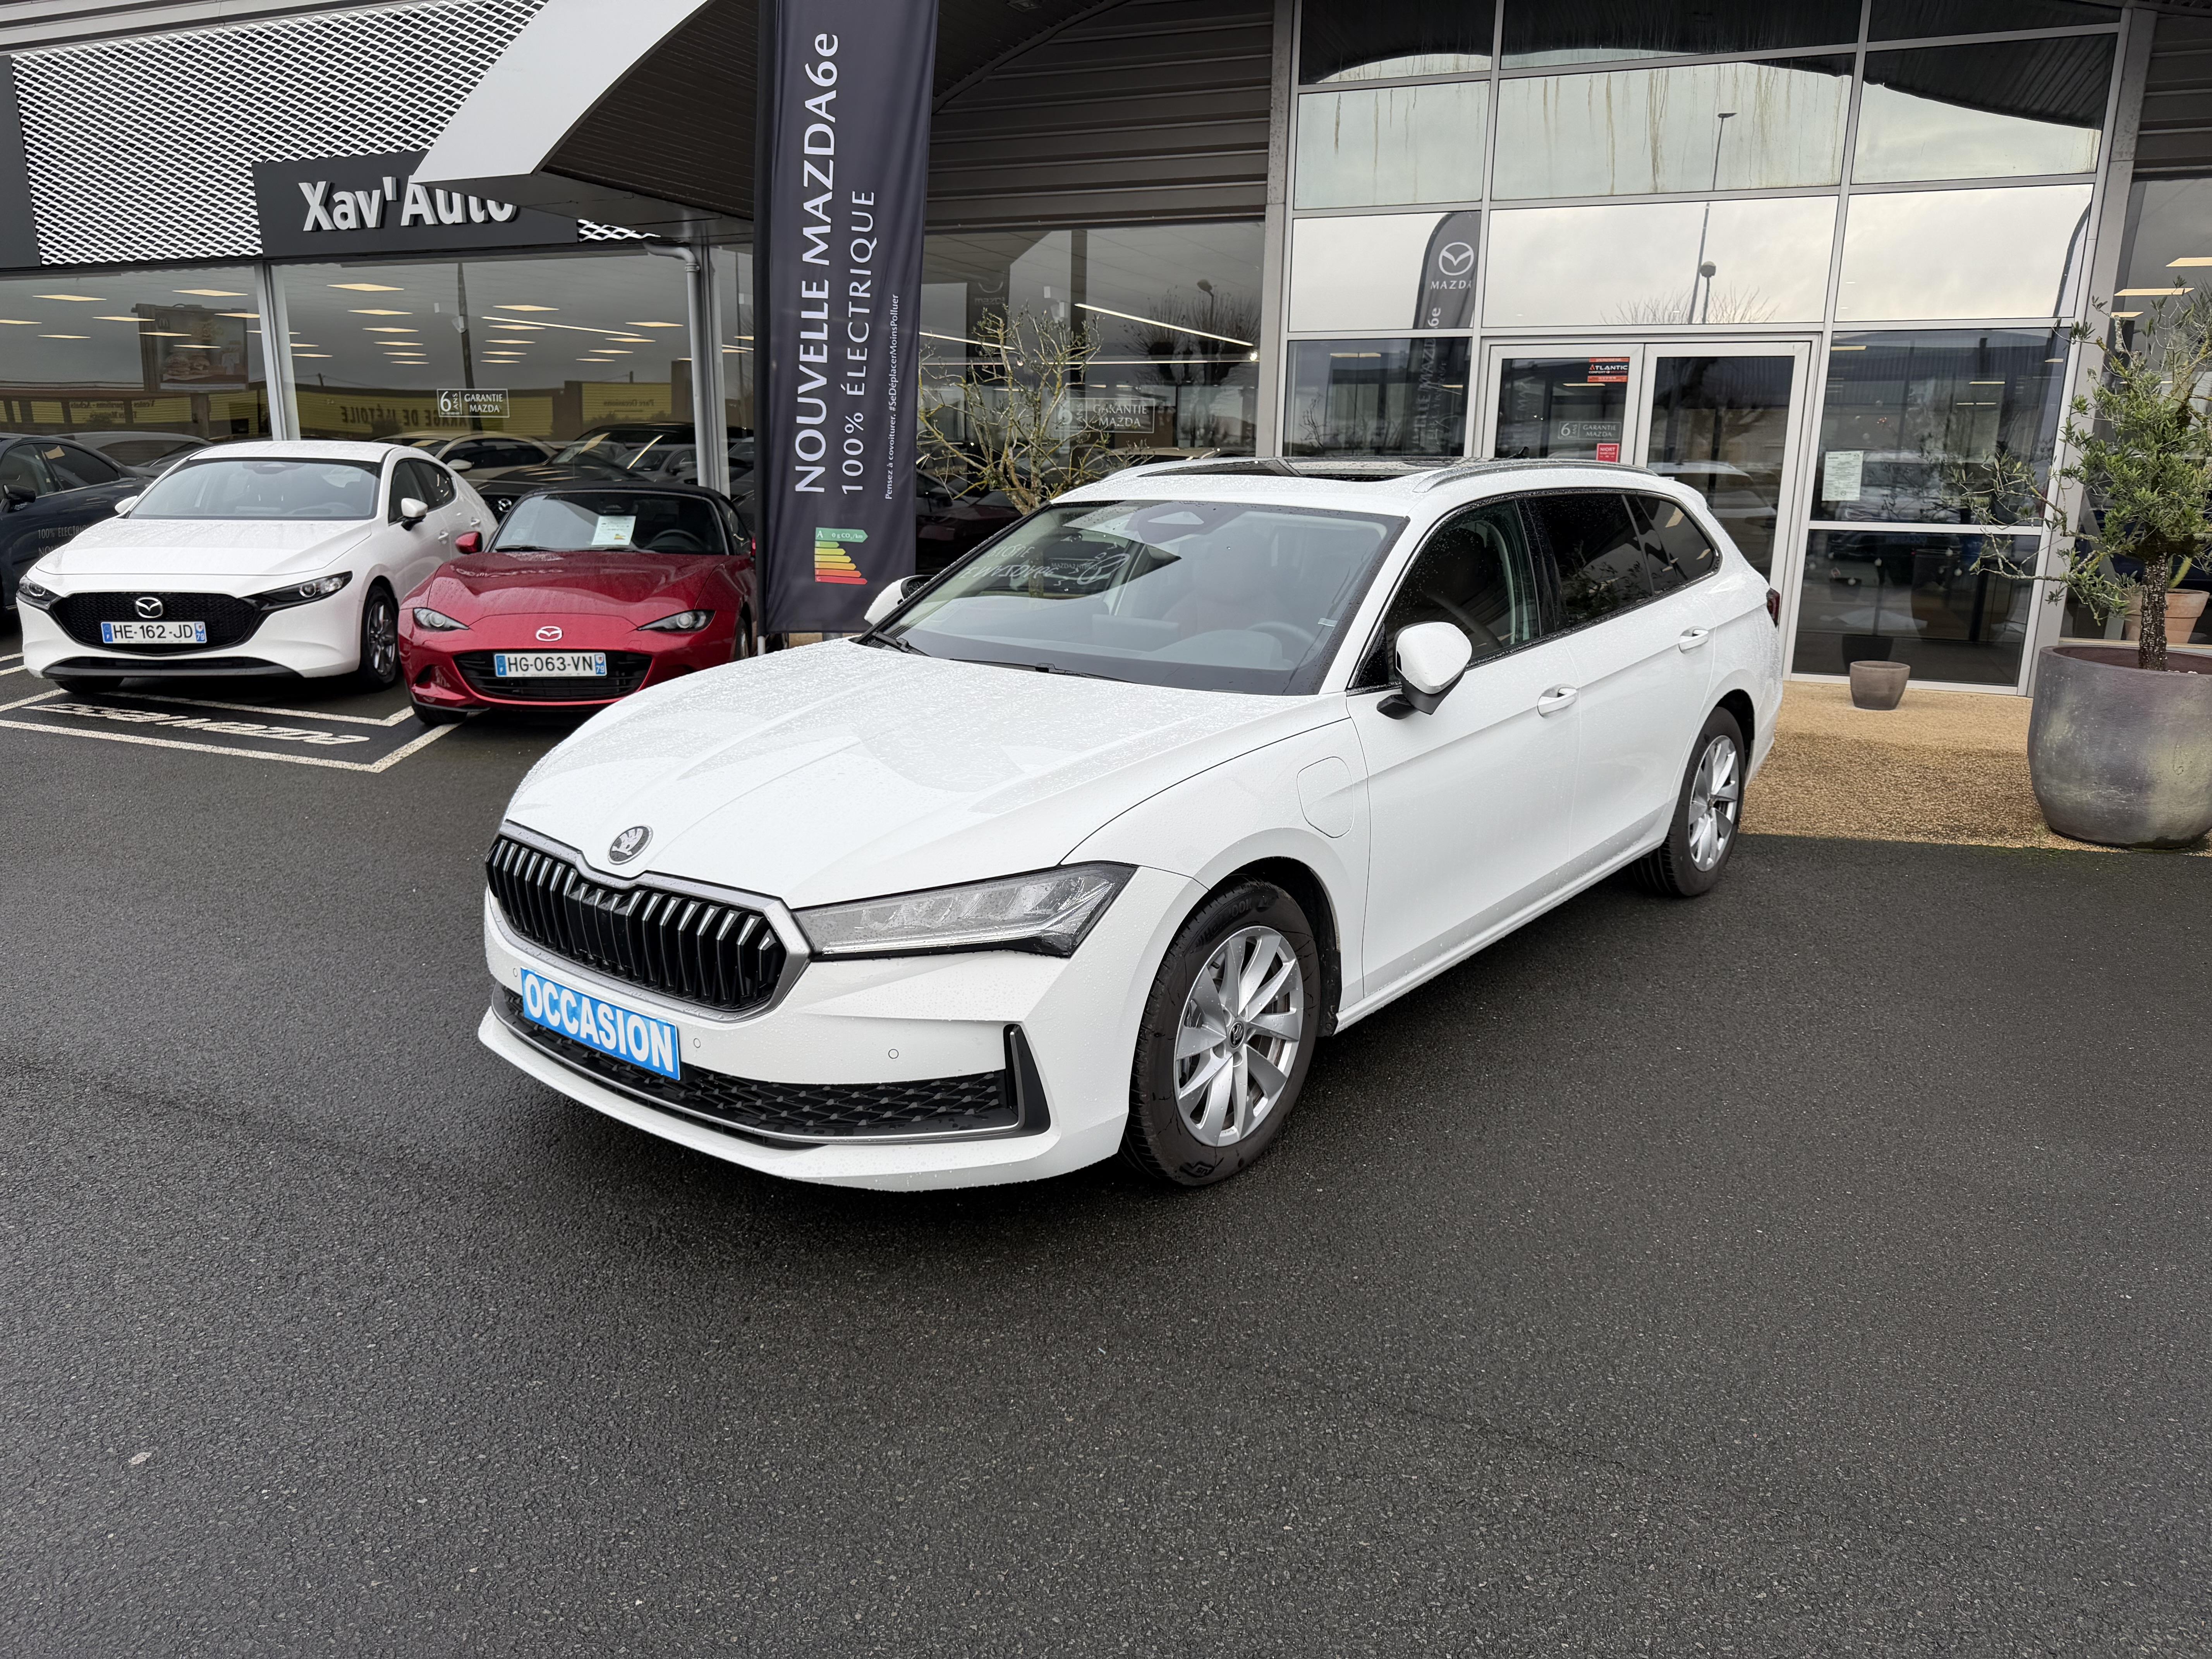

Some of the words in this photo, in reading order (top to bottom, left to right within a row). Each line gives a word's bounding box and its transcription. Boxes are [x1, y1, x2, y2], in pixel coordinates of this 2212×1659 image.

[802, 33, 839, 266] MAZDA6e
[1431, 280, 1472, 290] MAZDA
[841, 191, 877, 396] ÉLECTRIQUE
[888, 294, 898, 411] #SeDéplacerMoinsPolluer
[795, 279, 829, 493] NOUVELLE
[440, 391, 451, 408] 6
[464, 393, 503, 402] GARANTIE
[470, 404, 500, 413] MAZDA
[1099, 417, 1140, 427] MAZDA
[1561, 423, 1571, 436] 6
[842, 412, 864, 495] 100%
[817, 530, 823, 538] A
[113, 625, 193, 639] HE-162-JD
[508, 656, 593, 672] HG-063-VN
[525, 973, 674, 1073] OCCASION
